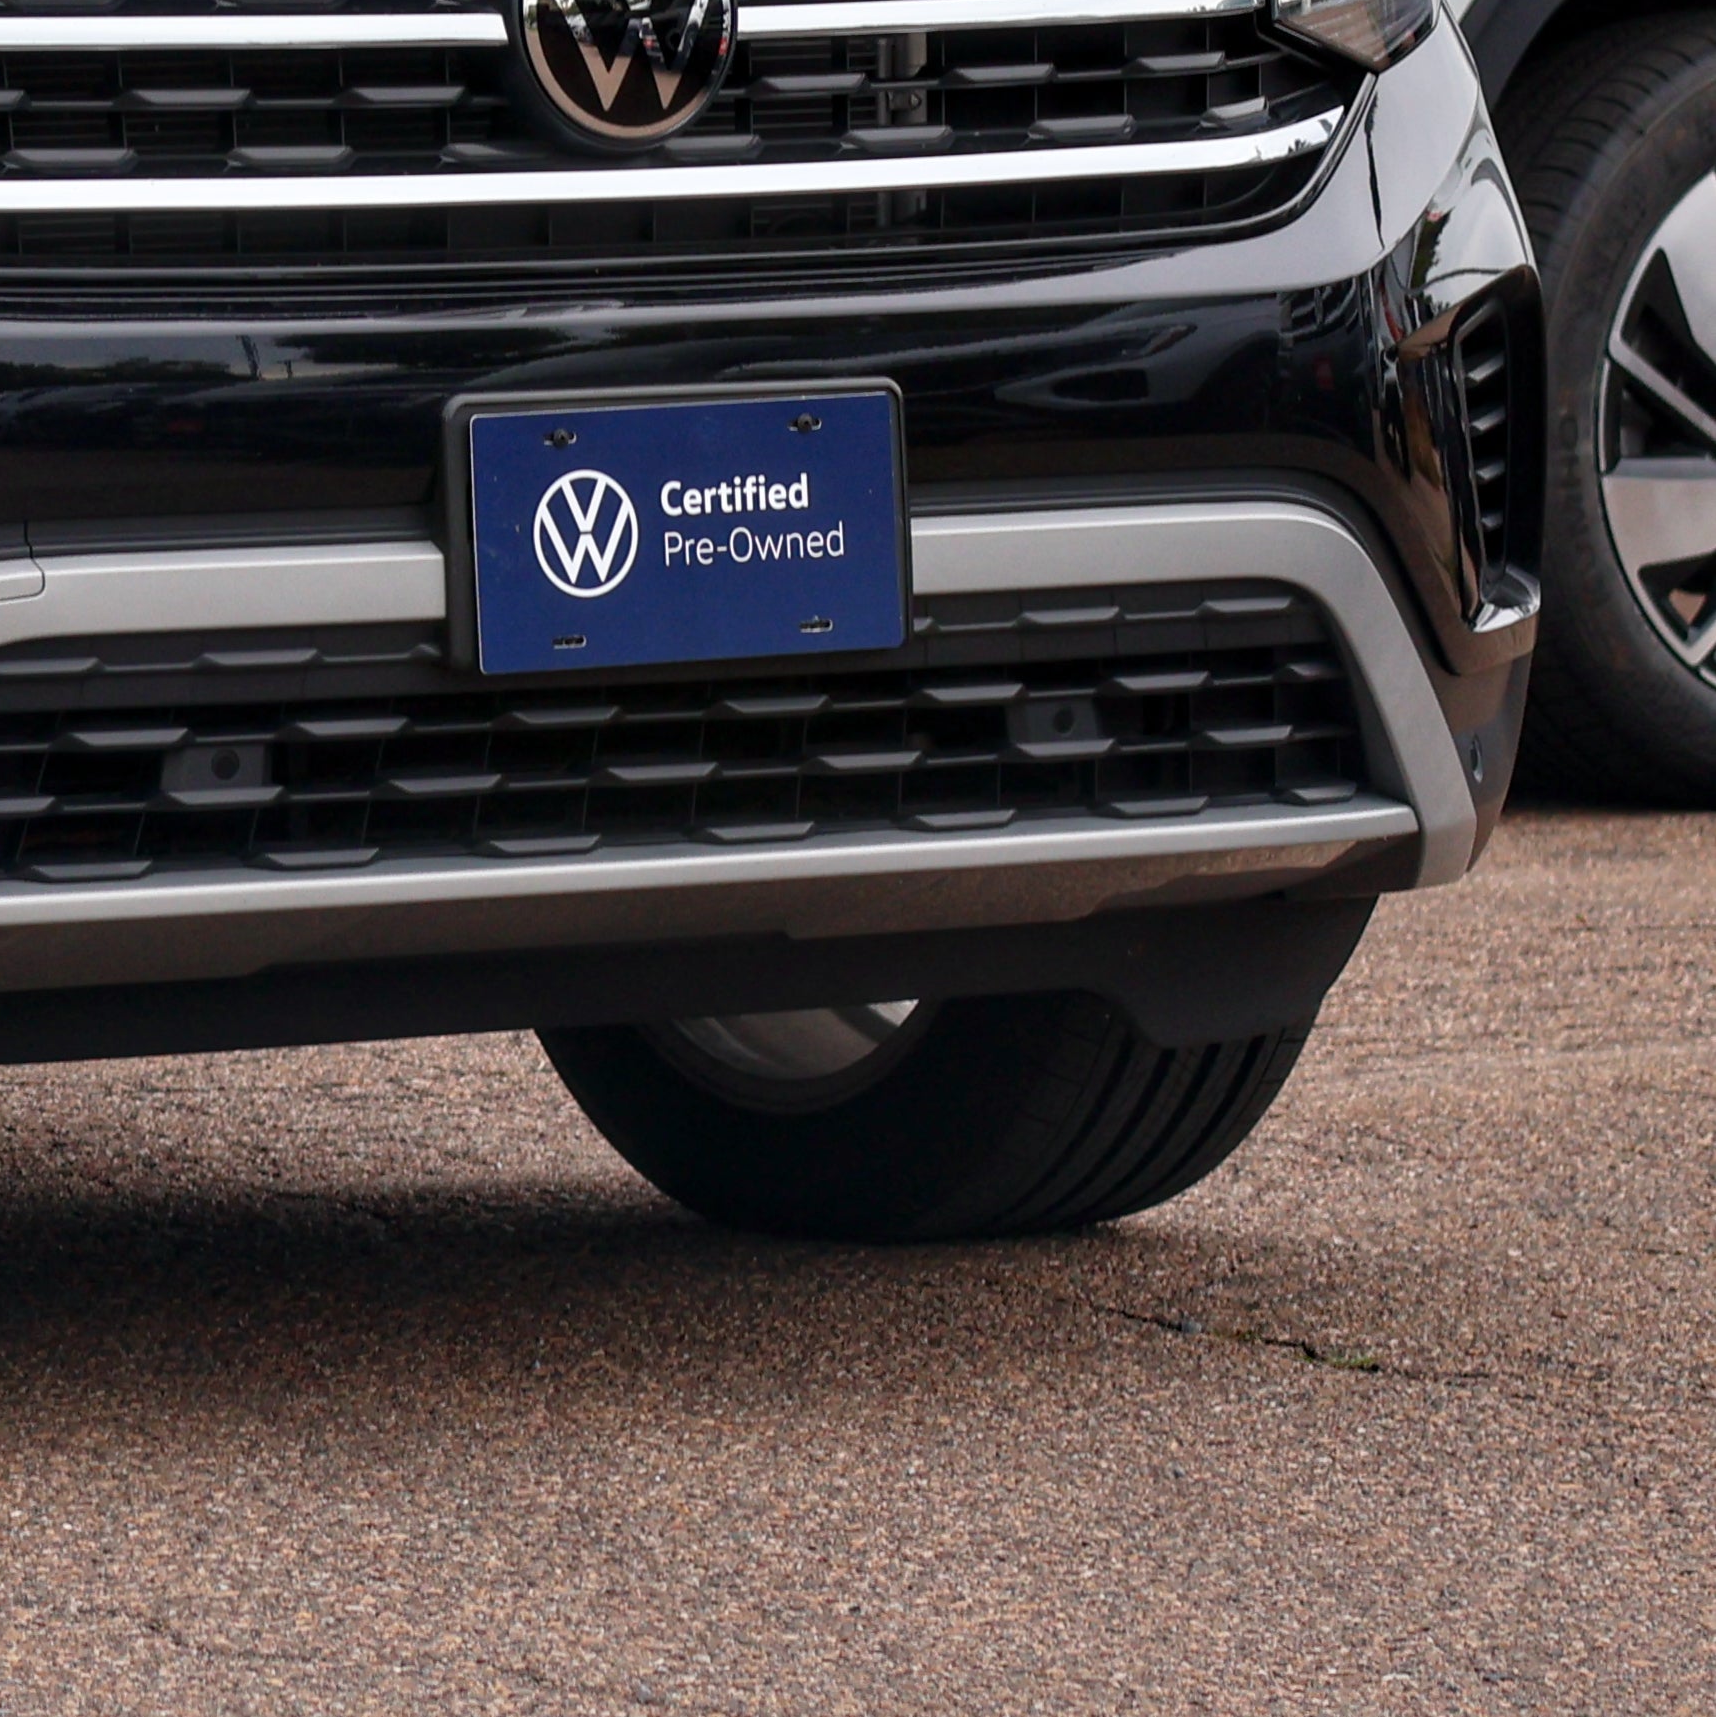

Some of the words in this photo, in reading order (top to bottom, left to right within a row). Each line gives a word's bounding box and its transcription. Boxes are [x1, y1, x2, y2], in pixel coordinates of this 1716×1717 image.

[660, 472, 810, 517] Certified
[533, 468, 639, 598] VW
[663, 520, 846, 567] Pre-Owned
